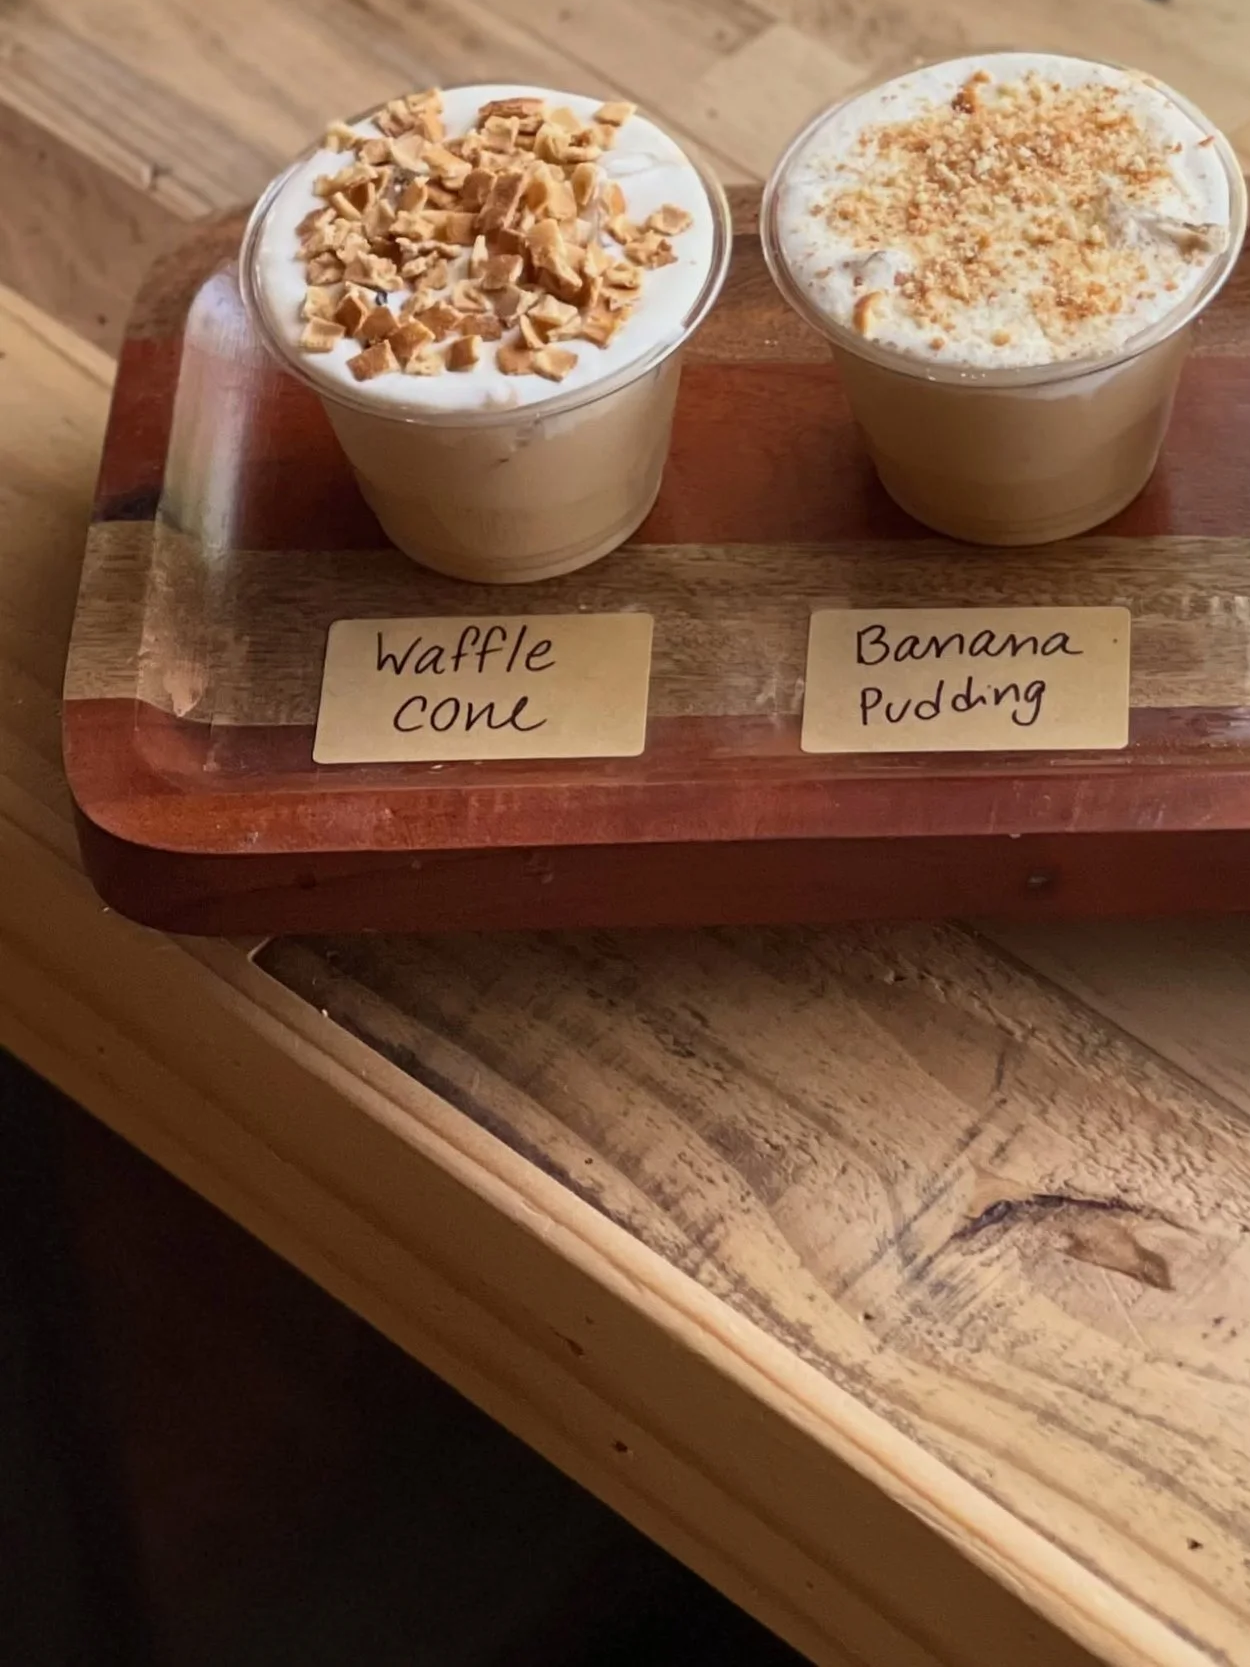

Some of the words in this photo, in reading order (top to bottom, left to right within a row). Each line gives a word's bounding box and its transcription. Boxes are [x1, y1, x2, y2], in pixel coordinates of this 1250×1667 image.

[376, 625, 556, 675] Waffle
[856, 624, 1084, 666] Banana
[859, 676, 1046, 726] Pudding
